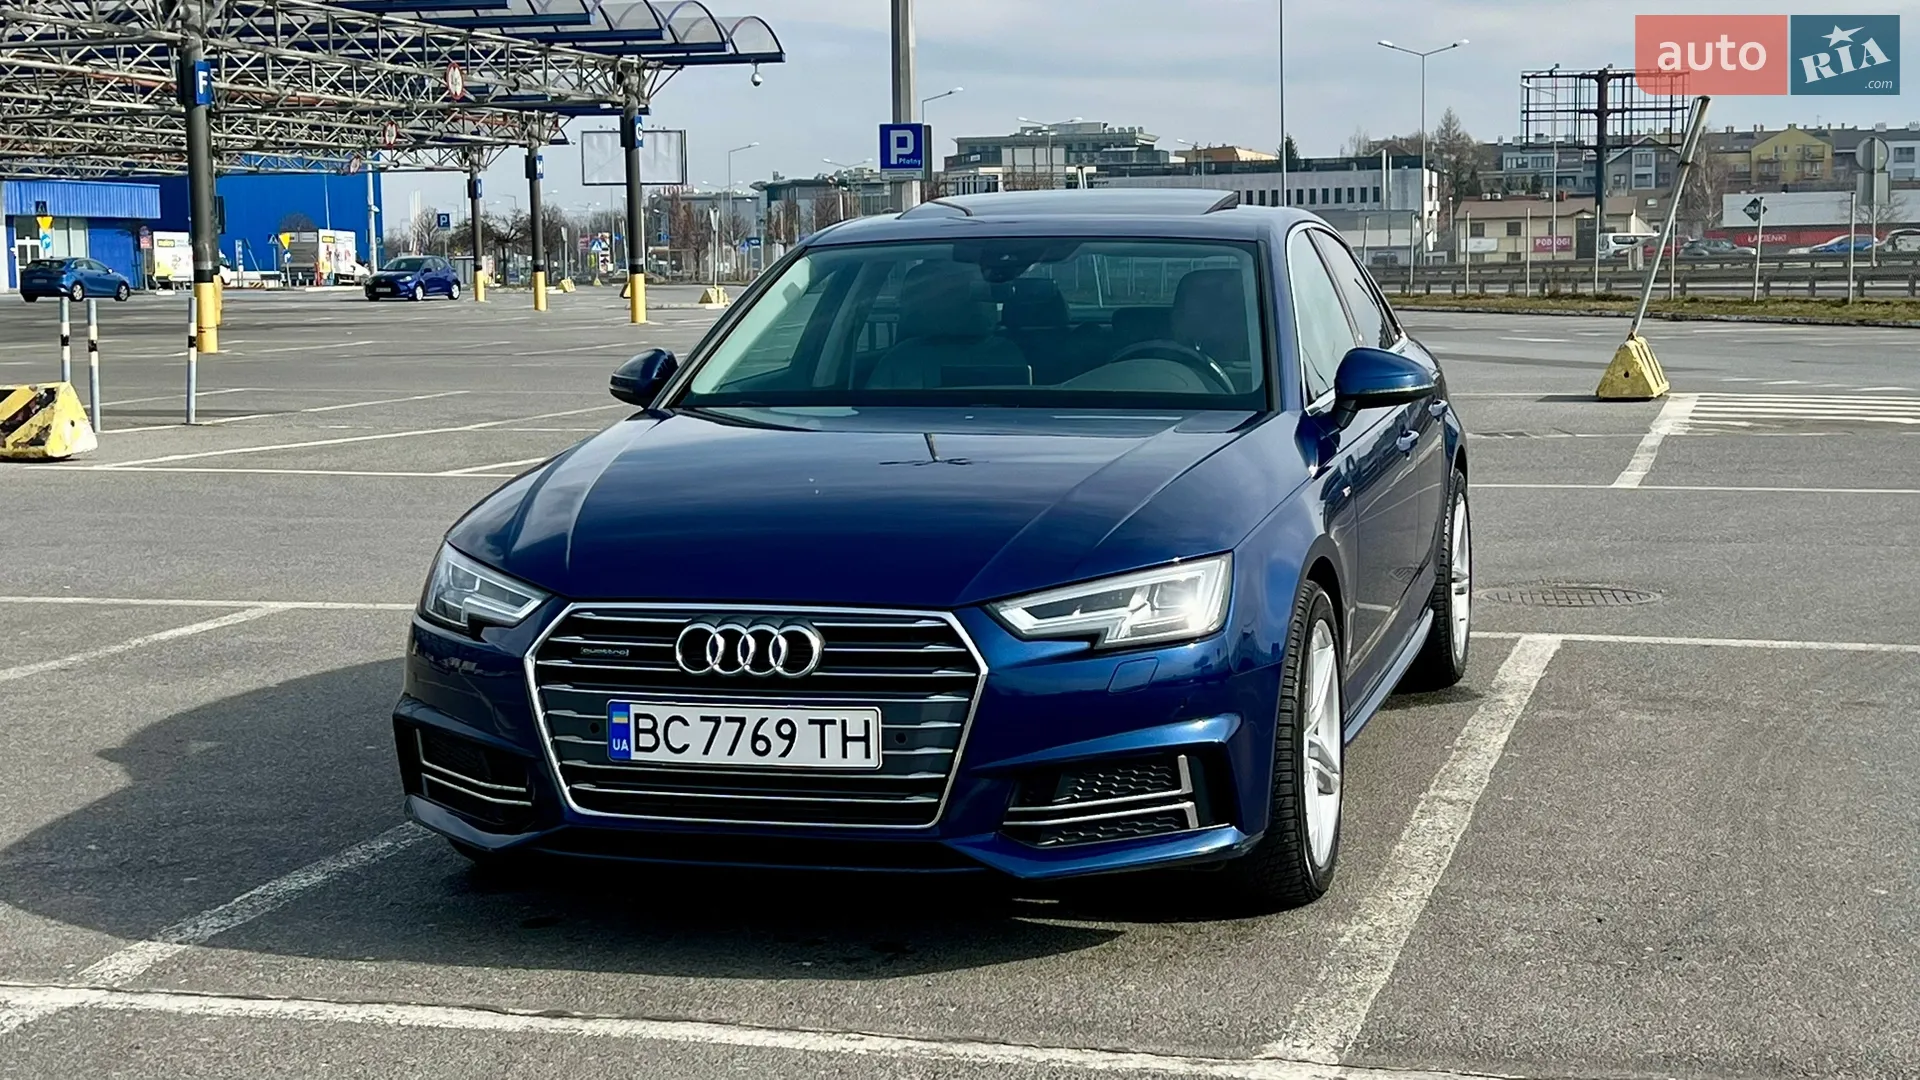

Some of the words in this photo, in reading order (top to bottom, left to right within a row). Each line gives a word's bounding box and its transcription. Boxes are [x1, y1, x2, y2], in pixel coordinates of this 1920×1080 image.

[198, 70, 208, 94] F
[635, 121, 643, 140] G
[890, 130, 914, 165] P
[1535, 238, 1571, 246] PODOGI
[612, 738, 629, 751] UA
[634, 713, 690, 754] BC
[700, 715, 797, 758] 7769
[808, 718, 871, 759] TH
